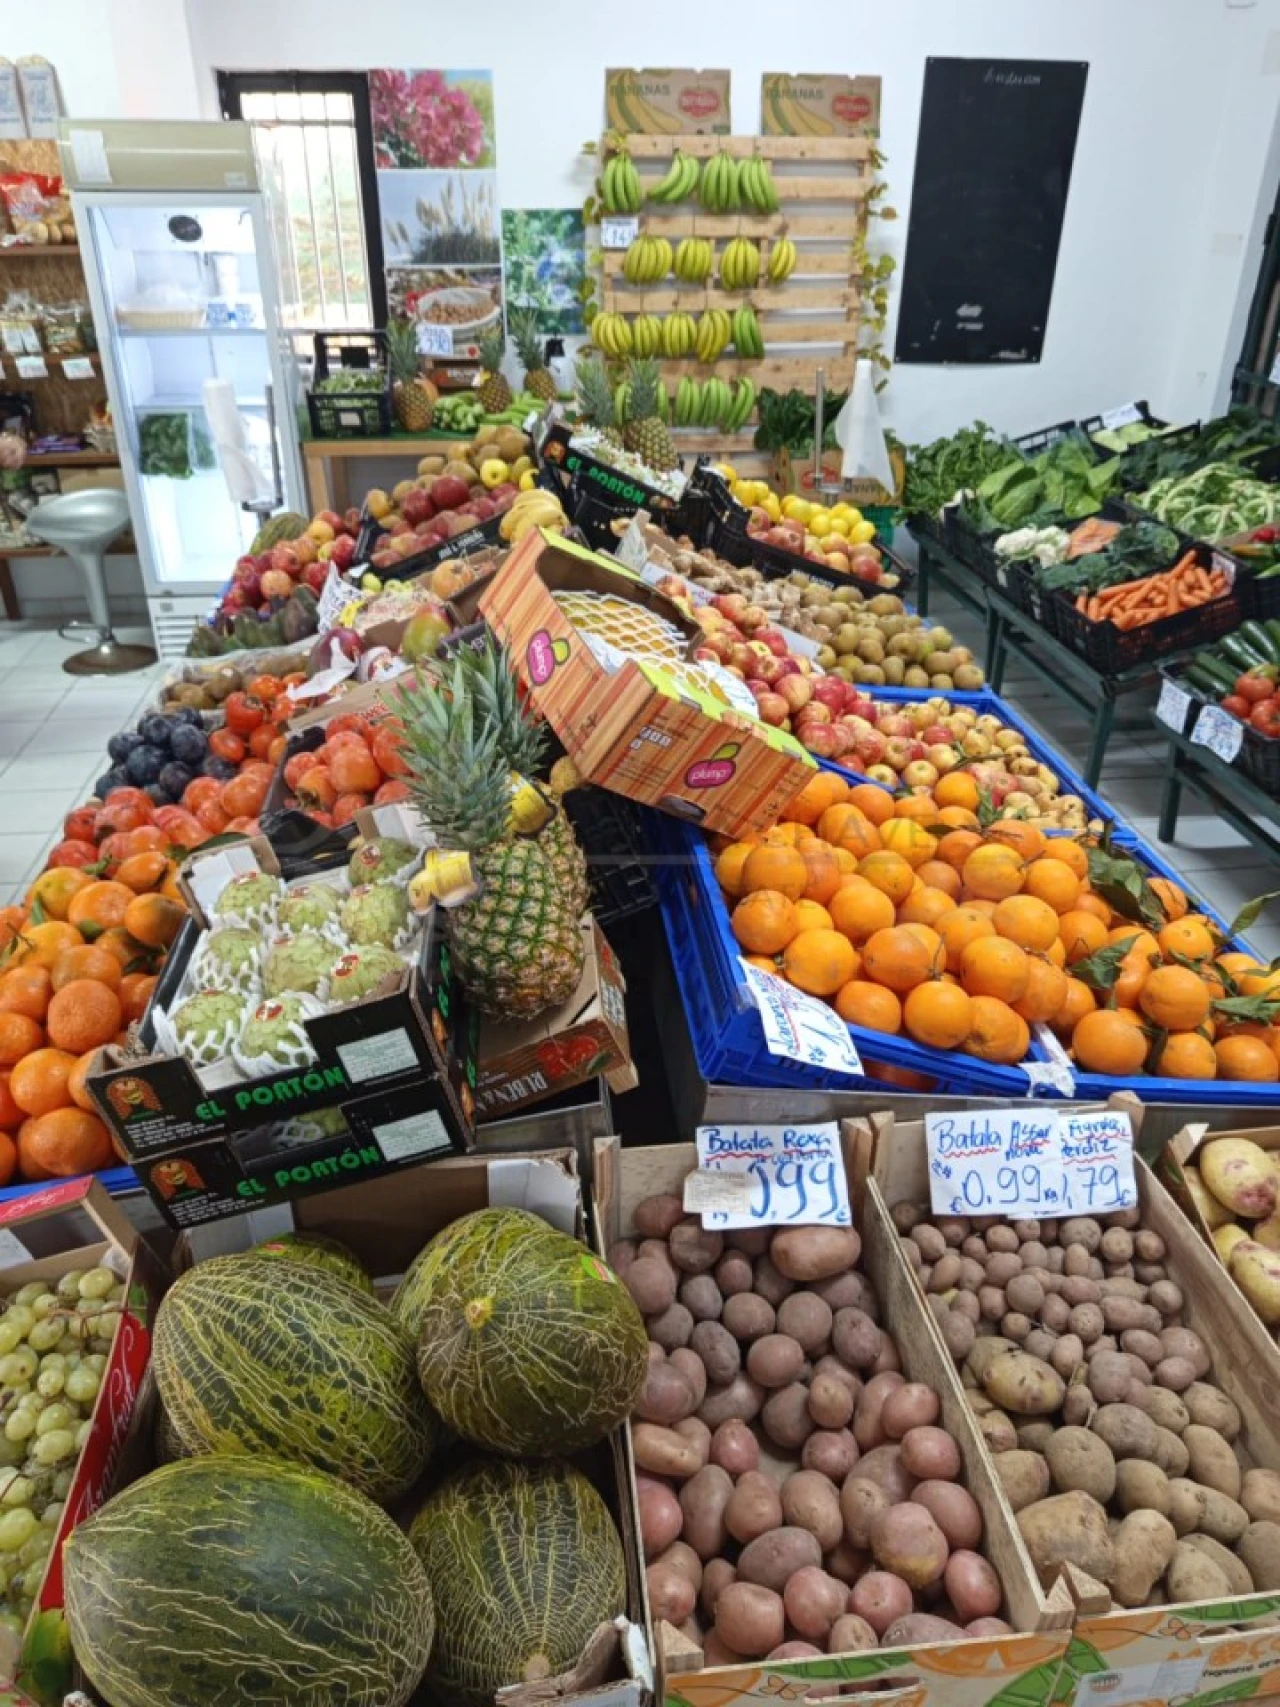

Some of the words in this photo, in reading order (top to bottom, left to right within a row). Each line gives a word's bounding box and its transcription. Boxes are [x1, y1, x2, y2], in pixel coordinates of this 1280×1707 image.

[195, 1101, 226, 1122] EL
[234, 1065, 344, 1110] PORTÓN
[702, 1128, 773, 1154] Batata
[933, 1119, 1001, 1155] Batata
[236, 1178, 267, 1197] EL
[274, 1145, 380, 1188] PORTÓN
